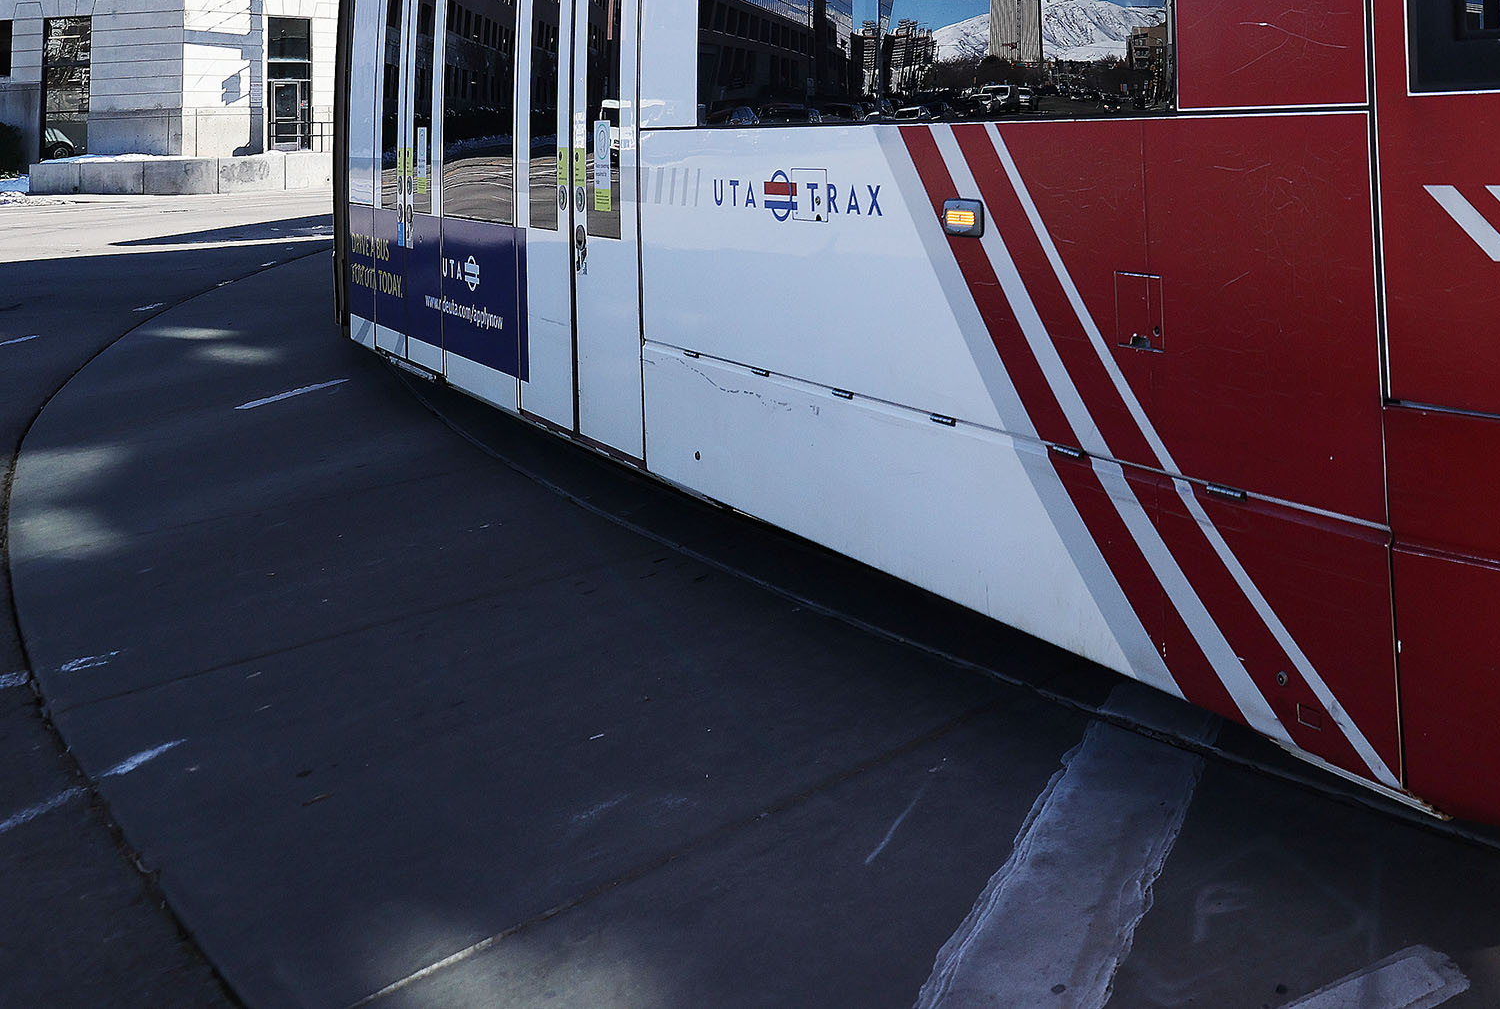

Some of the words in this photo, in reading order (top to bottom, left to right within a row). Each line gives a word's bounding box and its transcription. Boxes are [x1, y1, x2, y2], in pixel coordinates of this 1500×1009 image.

[714, 179, 756, 208] UTA
[806, 182, 882, 217] TRAX
[351, 232, 370, 256] DRIVE
[376, 237, 390, 261] BUS
[351, 263, 365, 285] FOR
[378, 269, 403, 298] TODAY.
[442, 257, 462, 280] UTA
